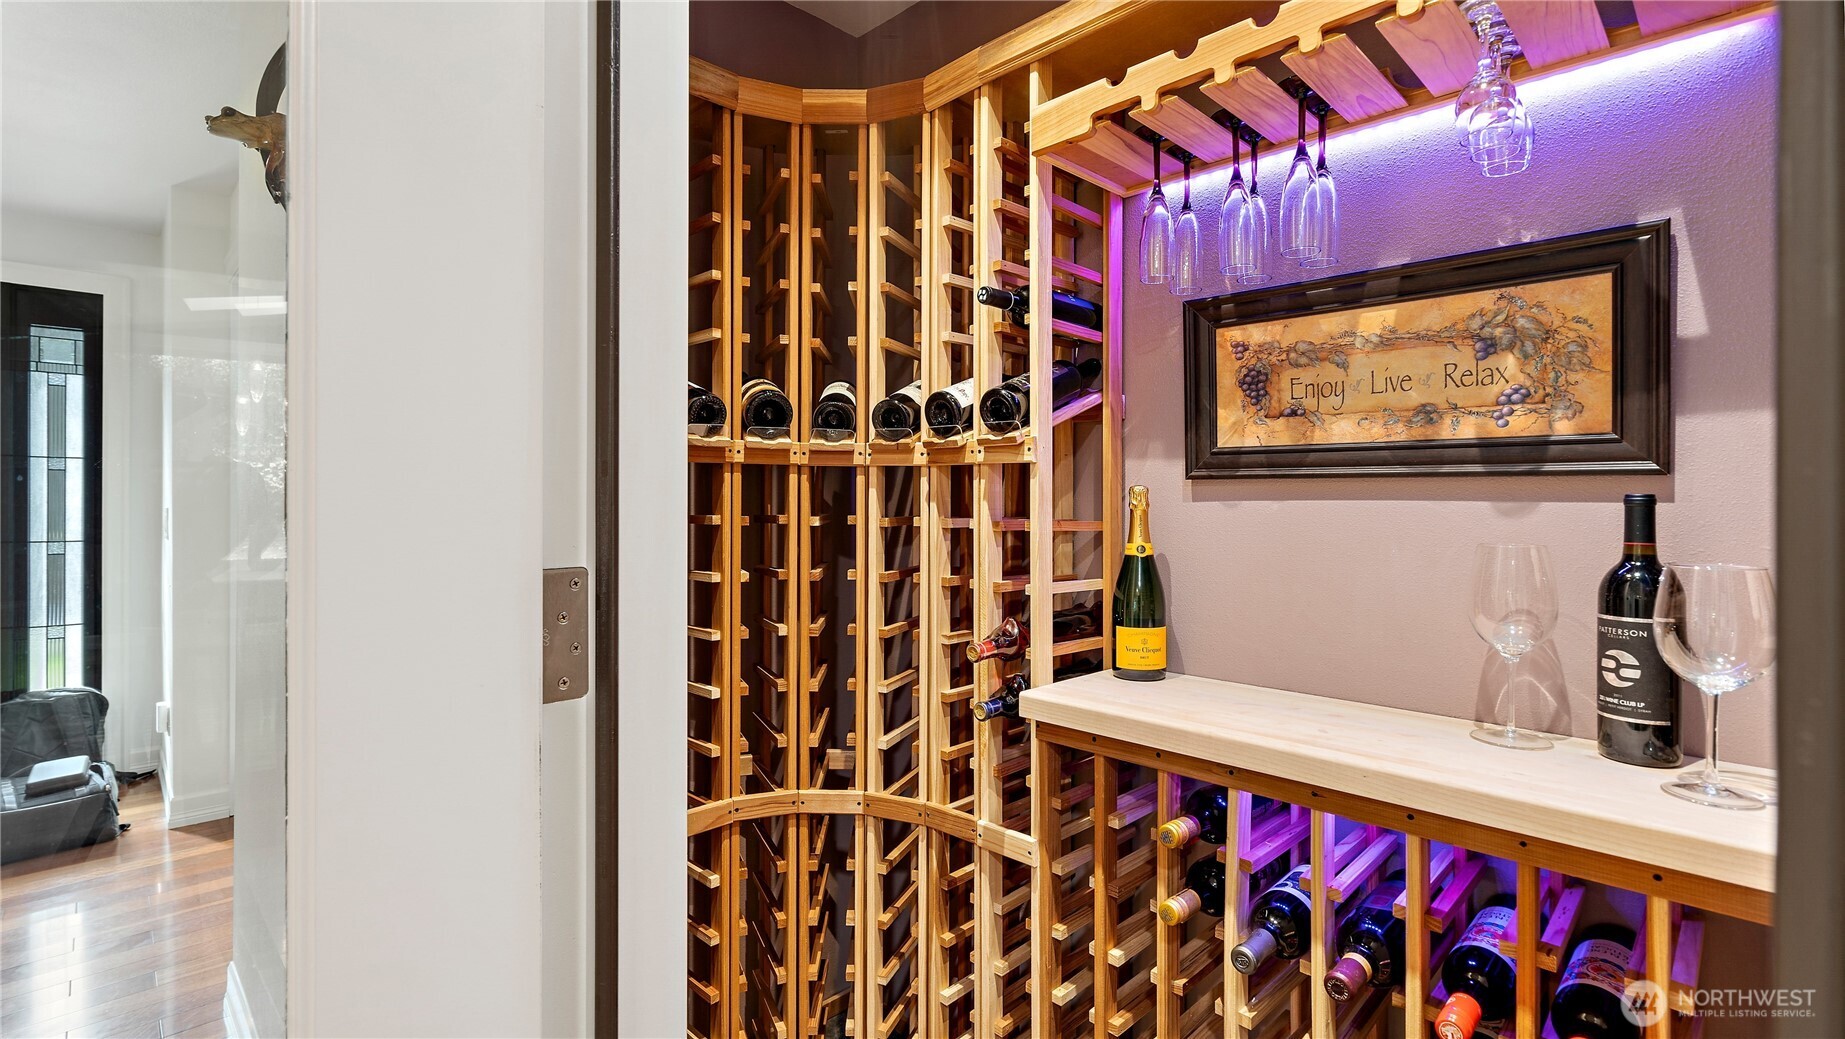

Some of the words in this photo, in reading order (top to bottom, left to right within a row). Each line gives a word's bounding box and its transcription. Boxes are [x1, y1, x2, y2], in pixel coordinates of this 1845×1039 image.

[1290, 373, 1345, 411] Enjoy
[1371, 367, 1413, 394] Live
[1443, 360, 1510, 389] Relax
[1598, 625, 1648, 638] PATTERSON
[1619, 699, 1637, 707] CLUB
